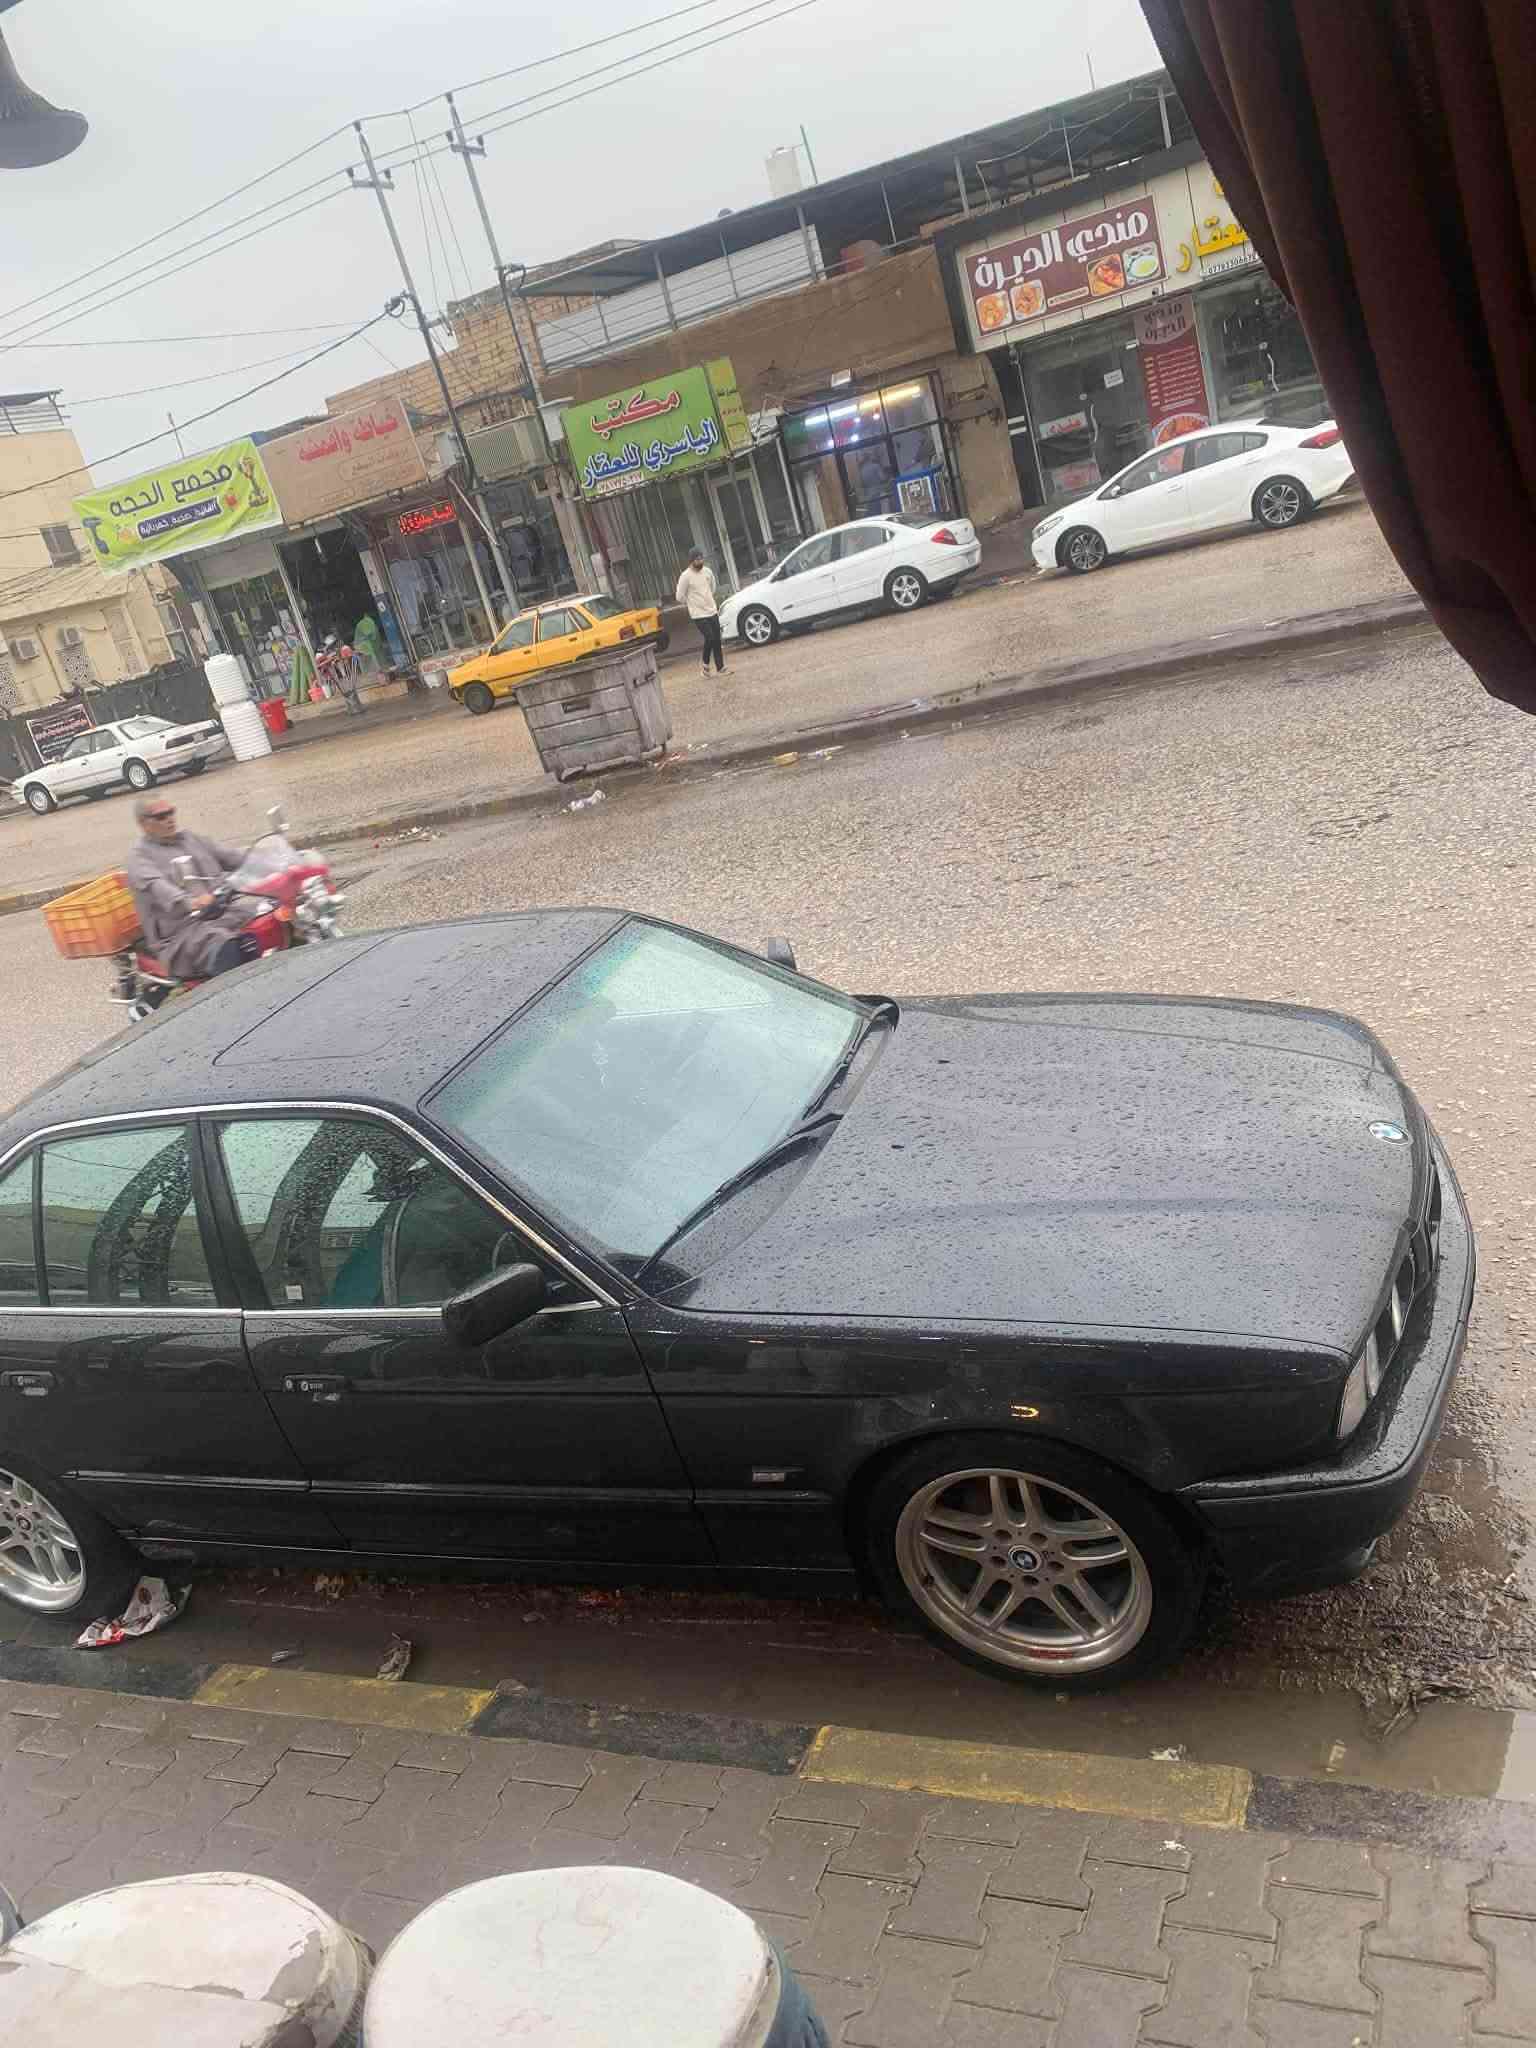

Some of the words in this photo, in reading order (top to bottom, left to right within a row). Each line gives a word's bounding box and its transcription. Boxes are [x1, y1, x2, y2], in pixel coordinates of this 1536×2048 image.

[975, 229, 1064, 290] الديرة
[1066, 211, 1149, 263] مندي
[591, 389, 681, 440] مكتب
[582, 441, 641, 488] للعقار
[642, 417, 719, 471] الياسري
[171, 464, 233, 503] مجمع
